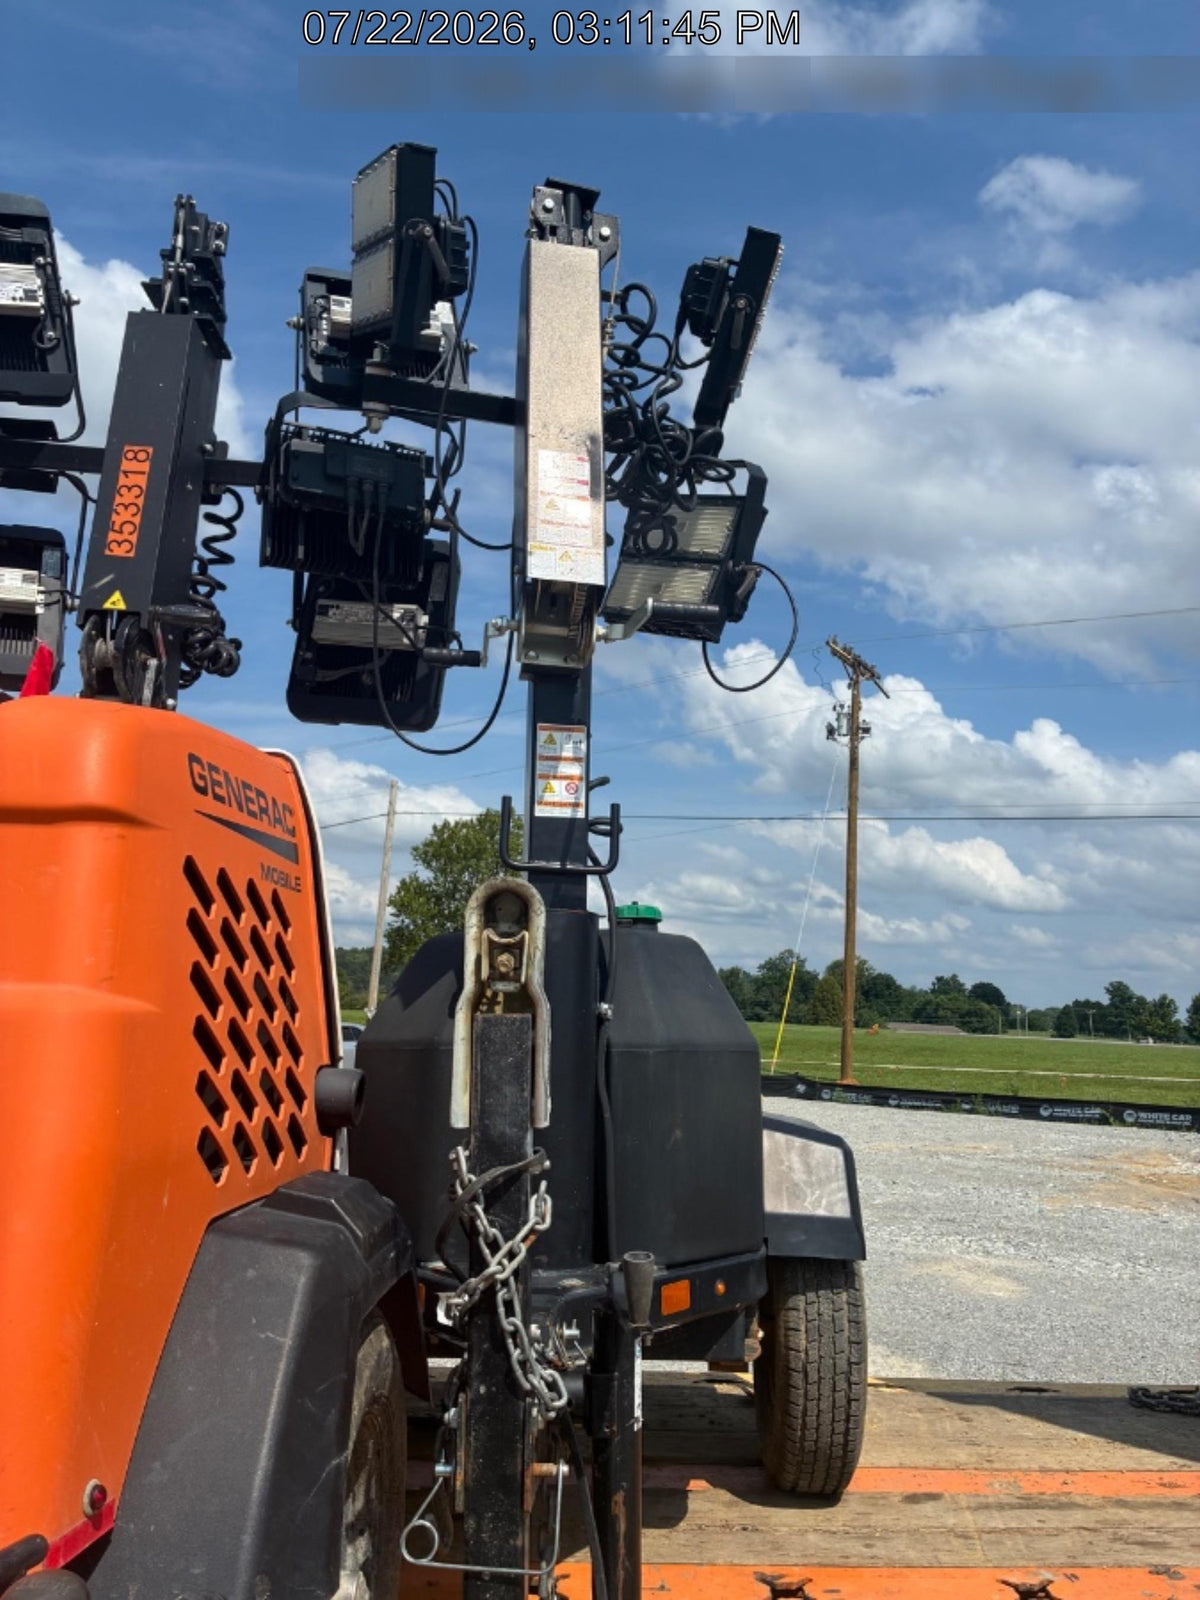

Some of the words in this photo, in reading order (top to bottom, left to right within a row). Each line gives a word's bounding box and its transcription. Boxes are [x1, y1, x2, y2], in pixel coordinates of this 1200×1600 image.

[107, 449, 150, 554] 353318
[187, 752, 296, 838] GENERAC
[260, 862, 302, 893] MOBILE
